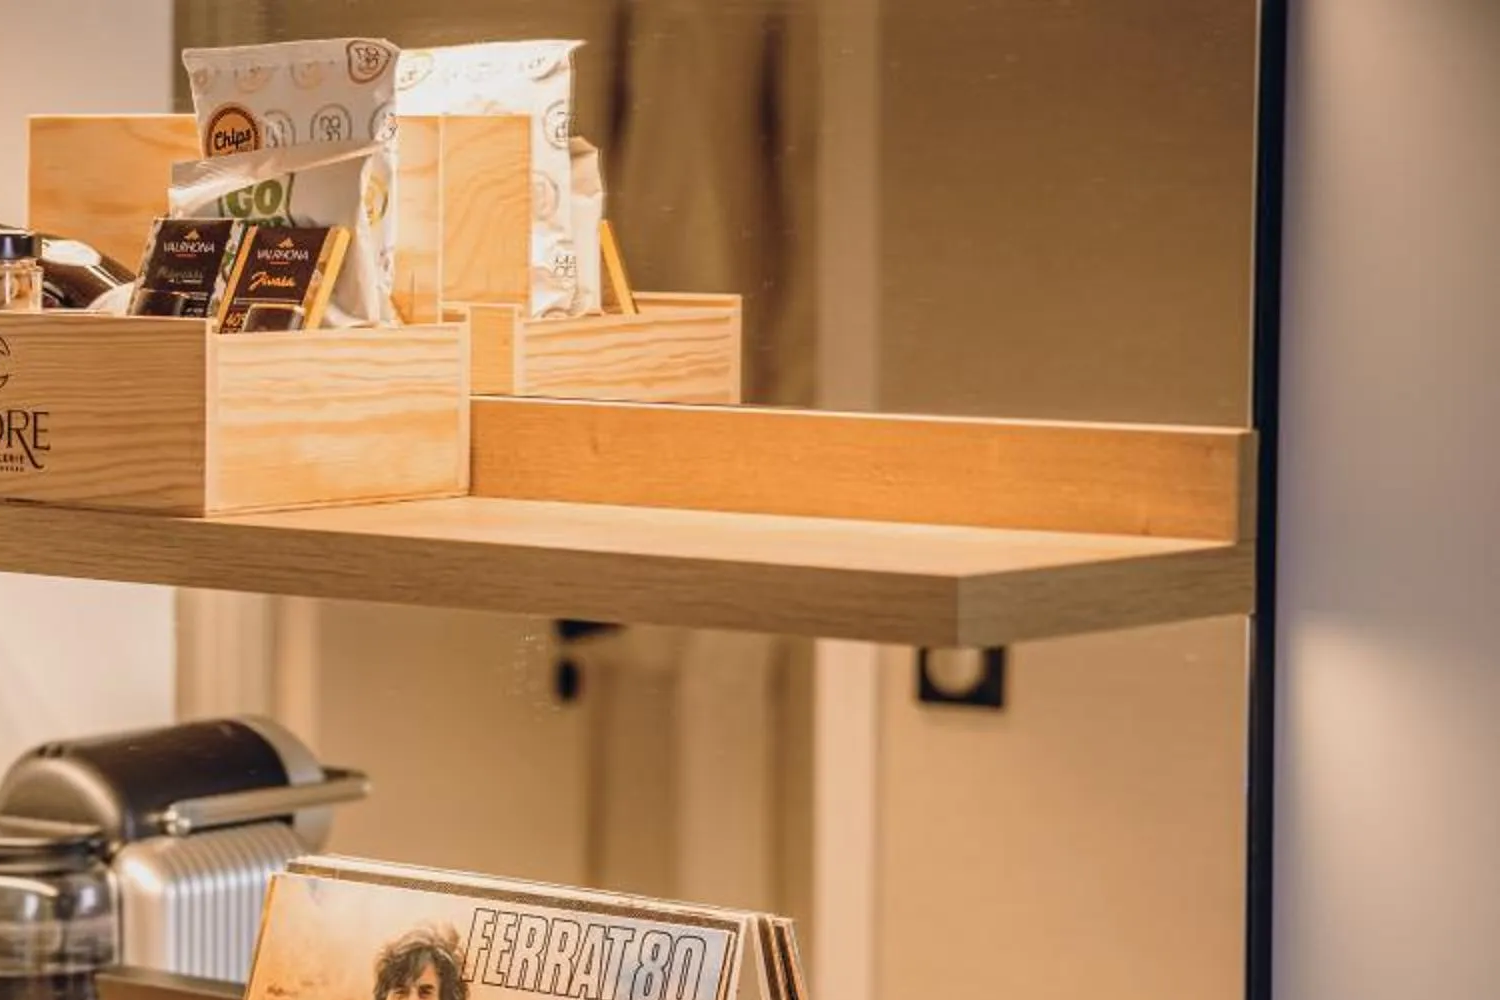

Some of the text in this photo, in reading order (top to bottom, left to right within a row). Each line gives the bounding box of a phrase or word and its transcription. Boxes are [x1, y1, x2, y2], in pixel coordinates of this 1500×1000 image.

[213, 127, 253, 151] Chips
[225, 179, 284, 219] GO
[162, 240, 216, 254] VALRHONA
[256, 249, 309, 262] VALRHONA
